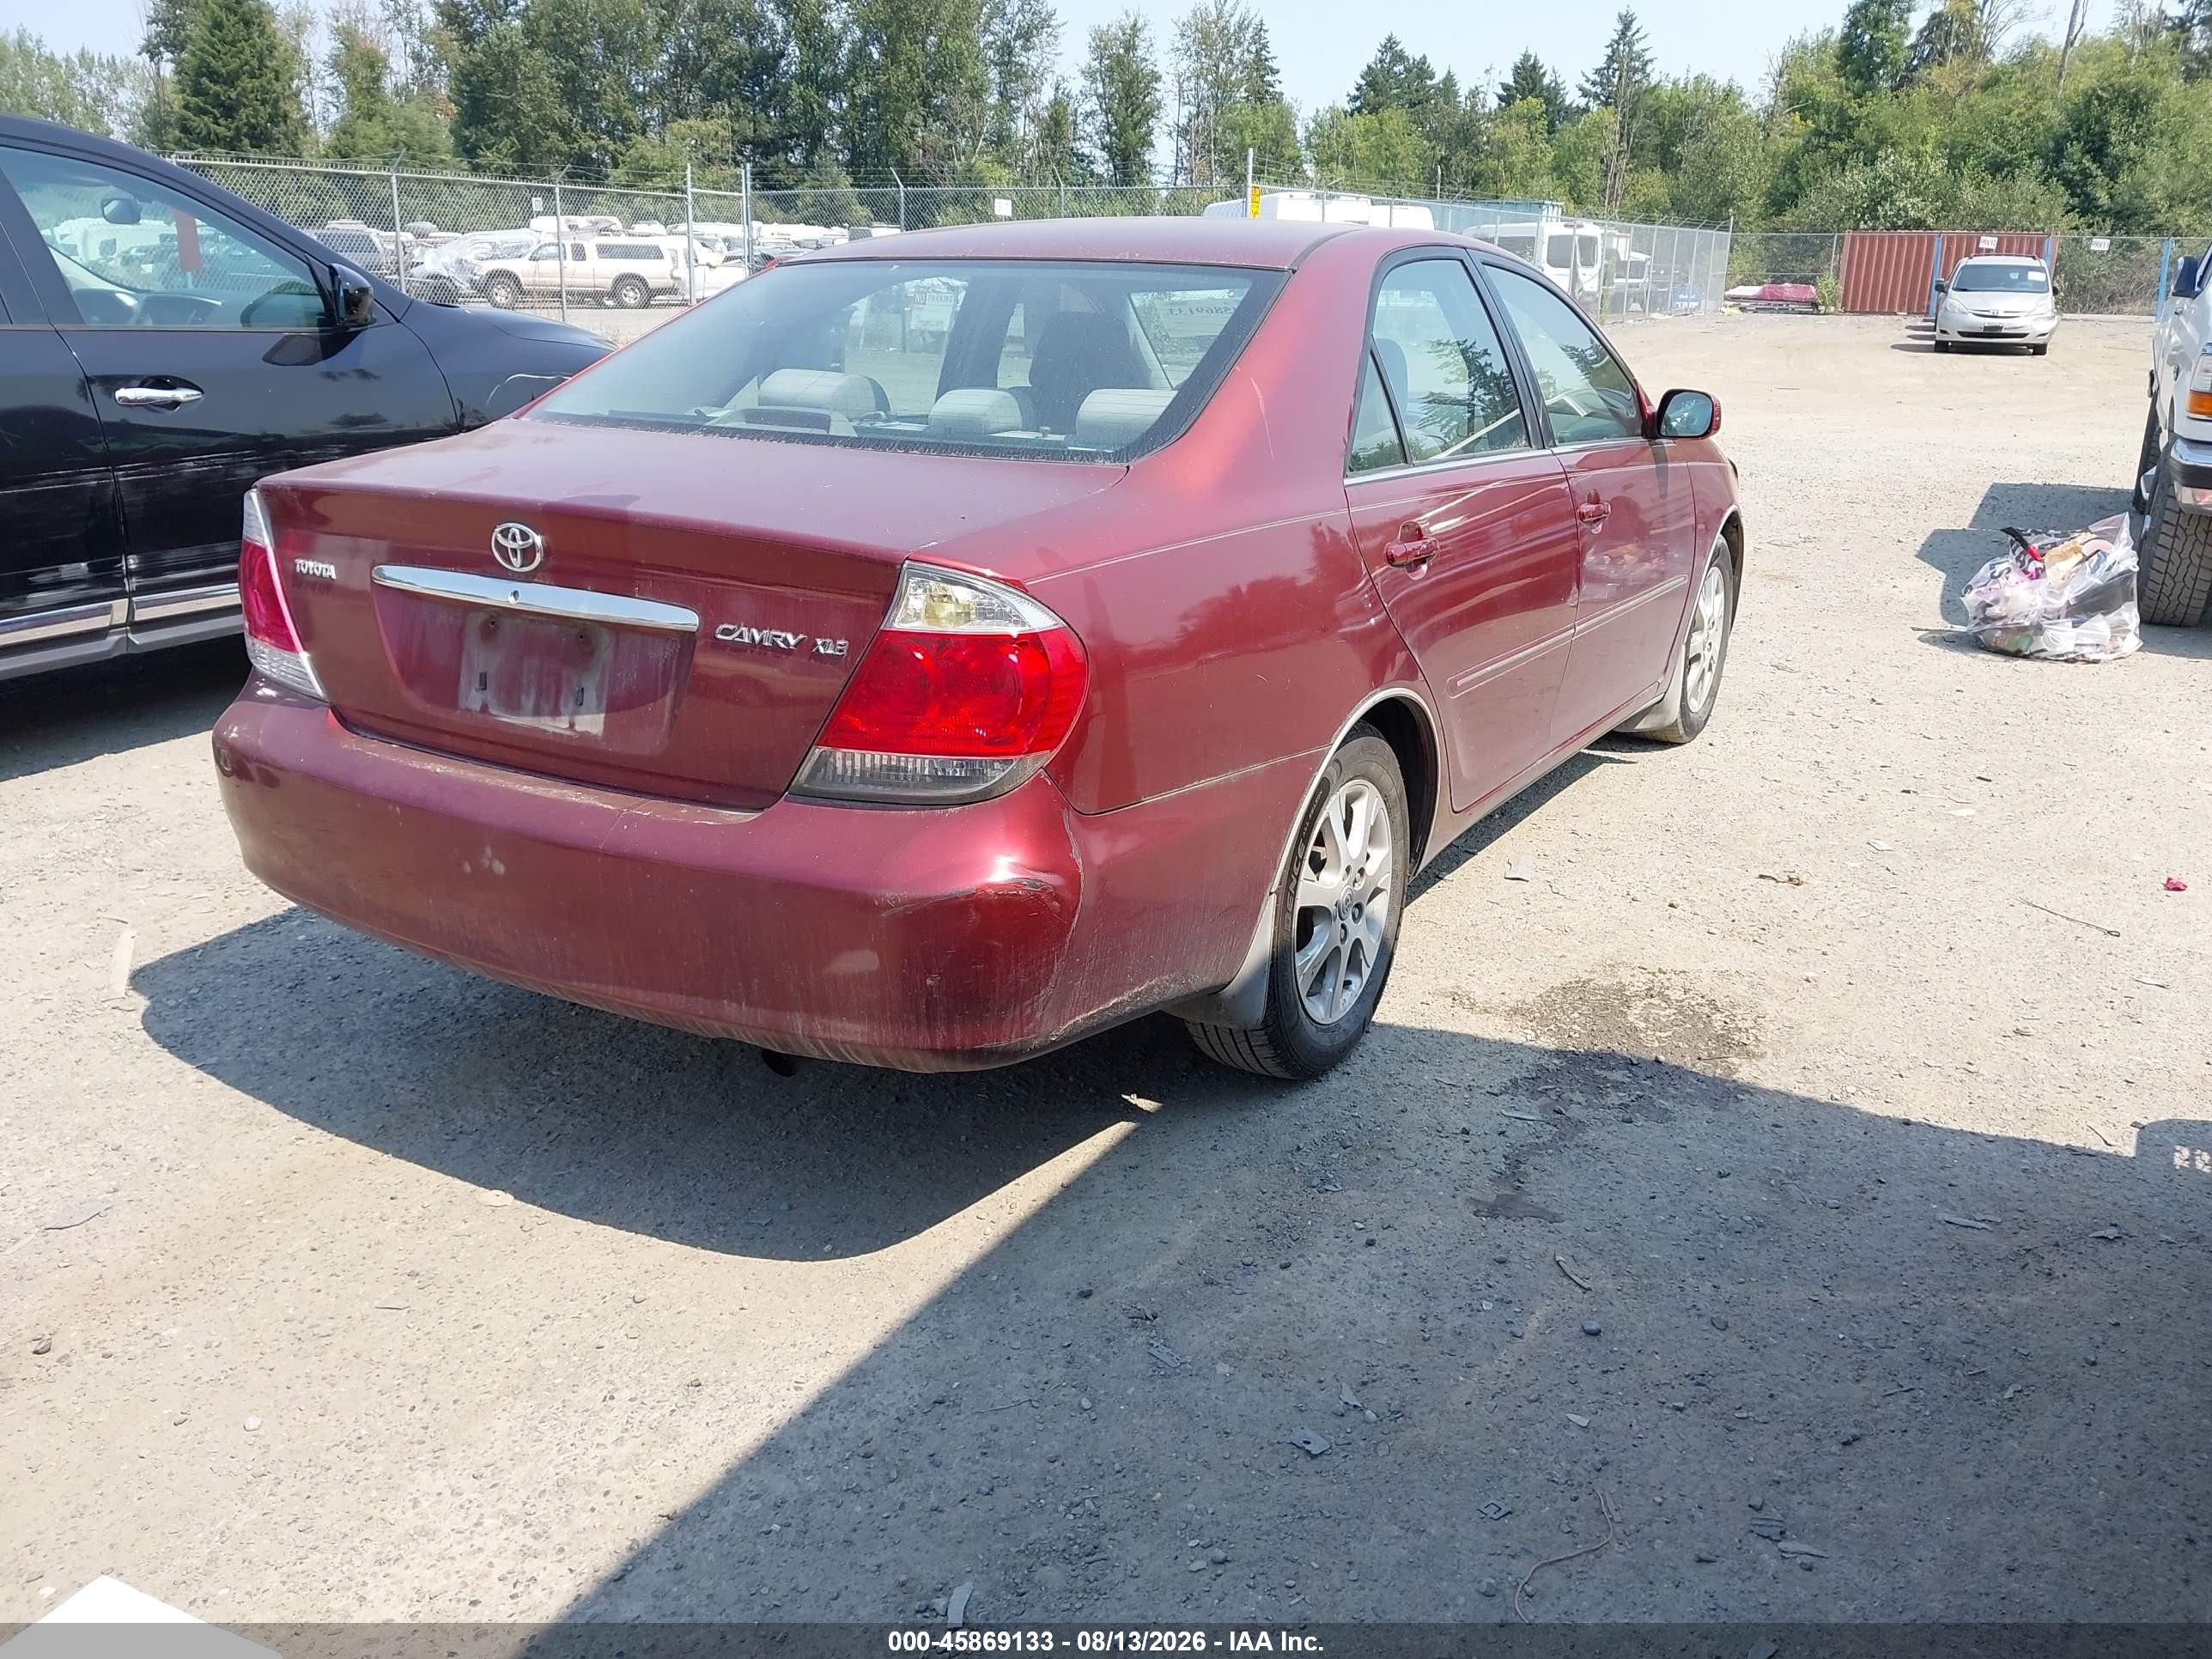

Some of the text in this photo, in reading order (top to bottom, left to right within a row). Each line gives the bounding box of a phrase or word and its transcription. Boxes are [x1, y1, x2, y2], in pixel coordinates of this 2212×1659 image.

[915, 293, 926, 303] NO
[295, 558, 337, 580] TOYOTA
[714, 622, 848, 655] CAMRY XLE
